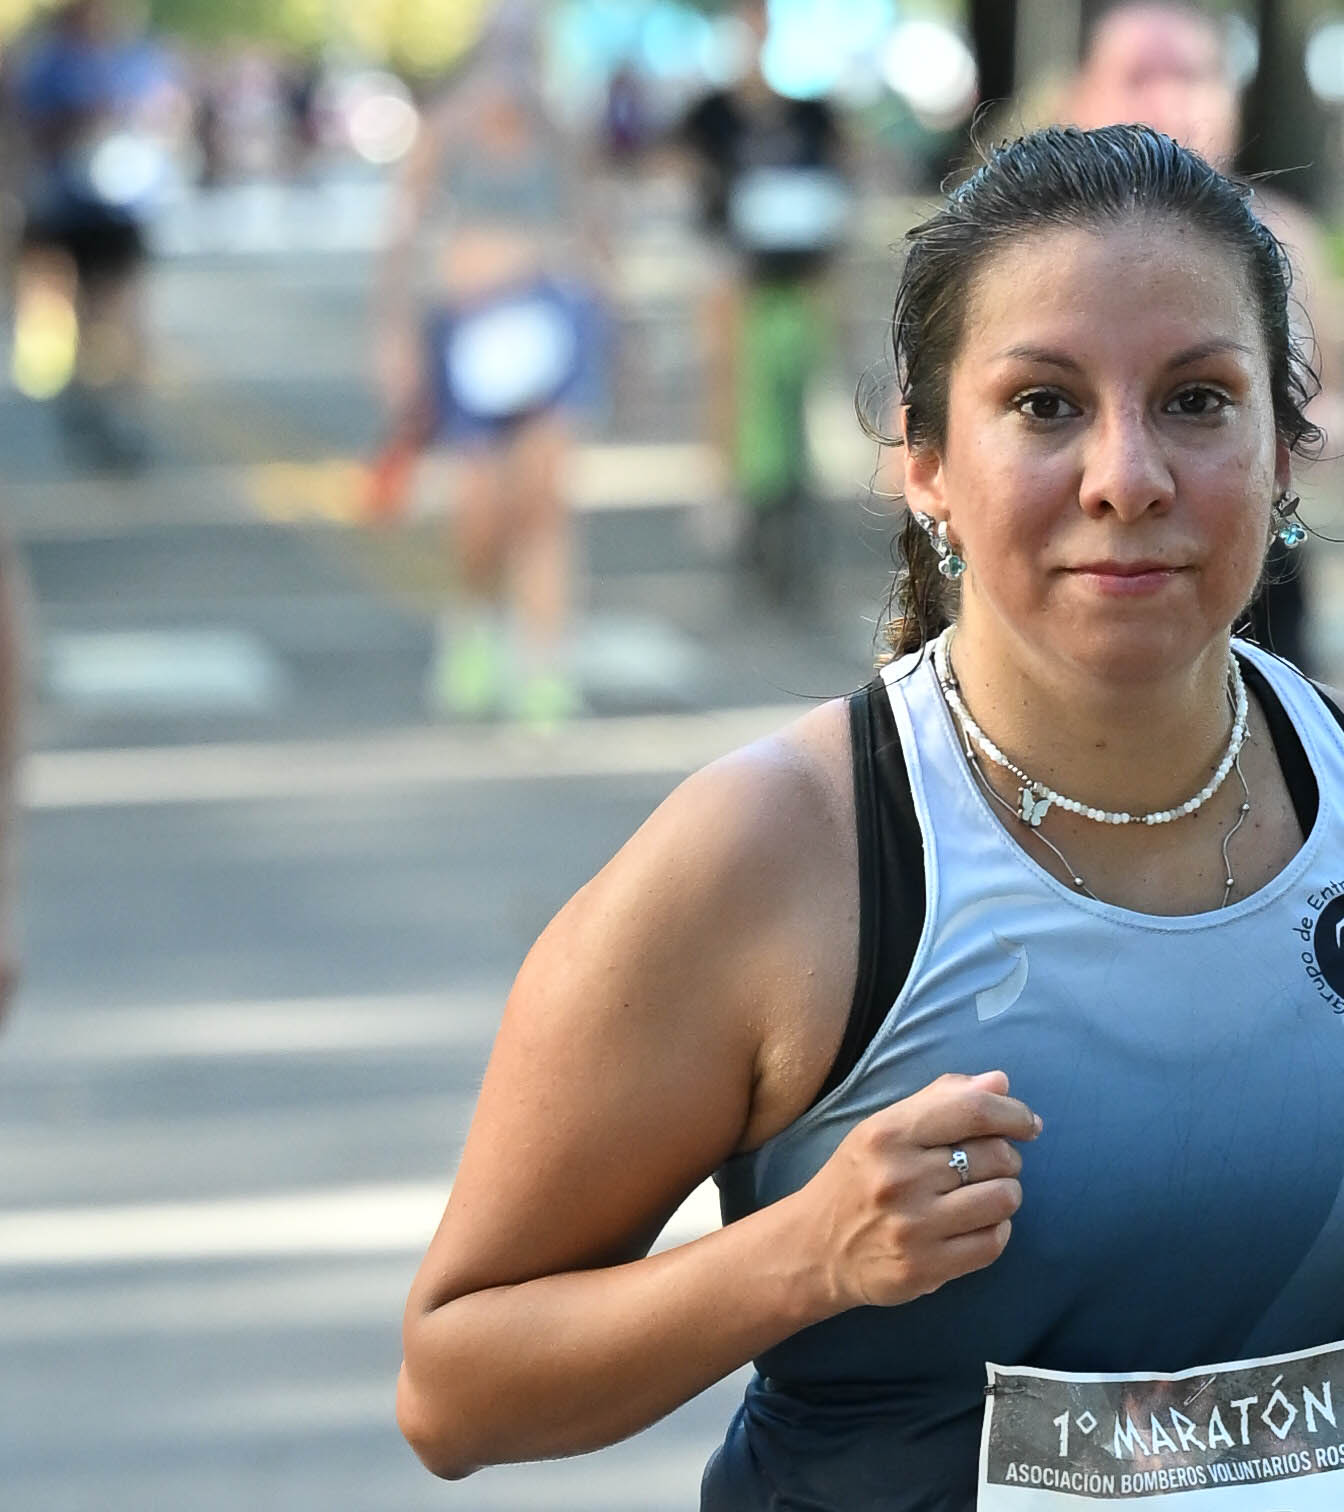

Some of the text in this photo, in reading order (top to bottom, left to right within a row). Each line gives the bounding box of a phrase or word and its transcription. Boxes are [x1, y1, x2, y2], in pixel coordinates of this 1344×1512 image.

[1293, 916, 1313, 941] de
[1113, 1374, 1338, 1459] MARATÓN
[1005, 1462, 1115, 1493] ASOCIACIÓN
[1121, 1466, 1207, 1493] BOMBEROS
[1208, 1451, 1312, 1483] VOLUNTARIOS
